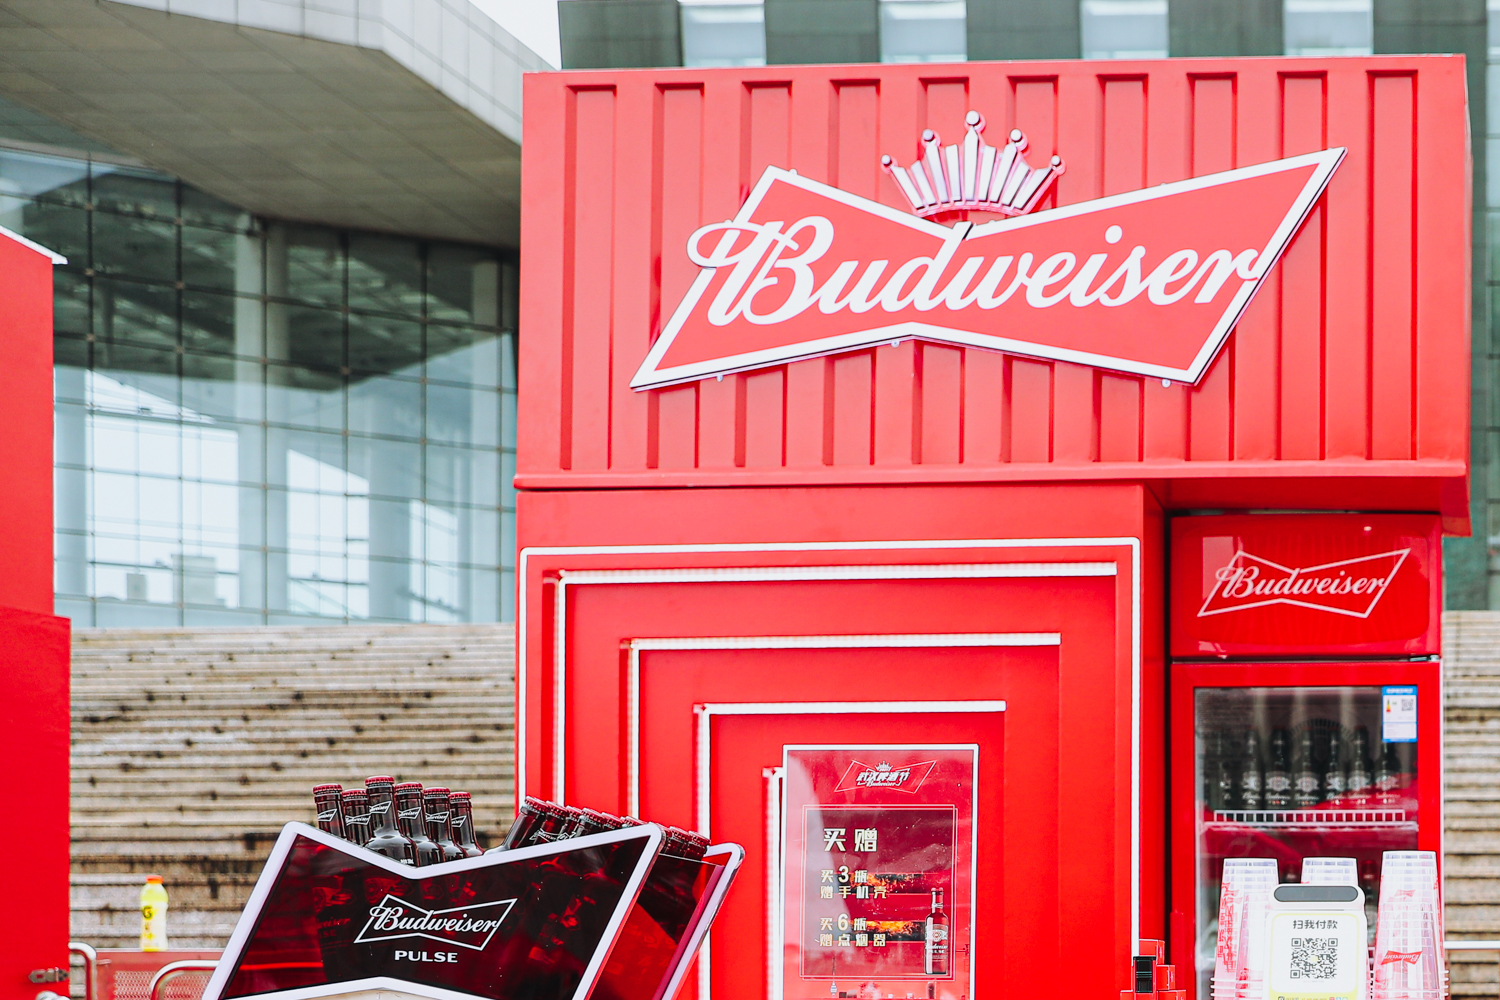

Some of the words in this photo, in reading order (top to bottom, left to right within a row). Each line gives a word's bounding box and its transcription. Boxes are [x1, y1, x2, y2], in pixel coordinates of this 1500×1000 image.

[686, 215, 1260, 326] Budweiser
[1215, 565, 1386, 598] Budweiser
[823, 828, 878, 852] 买赠
[369, 905, 503, 933] Budweiser
[1292, 919, 1338, 930] 扫我付款
[394, 950, 458, 963] PULSE
